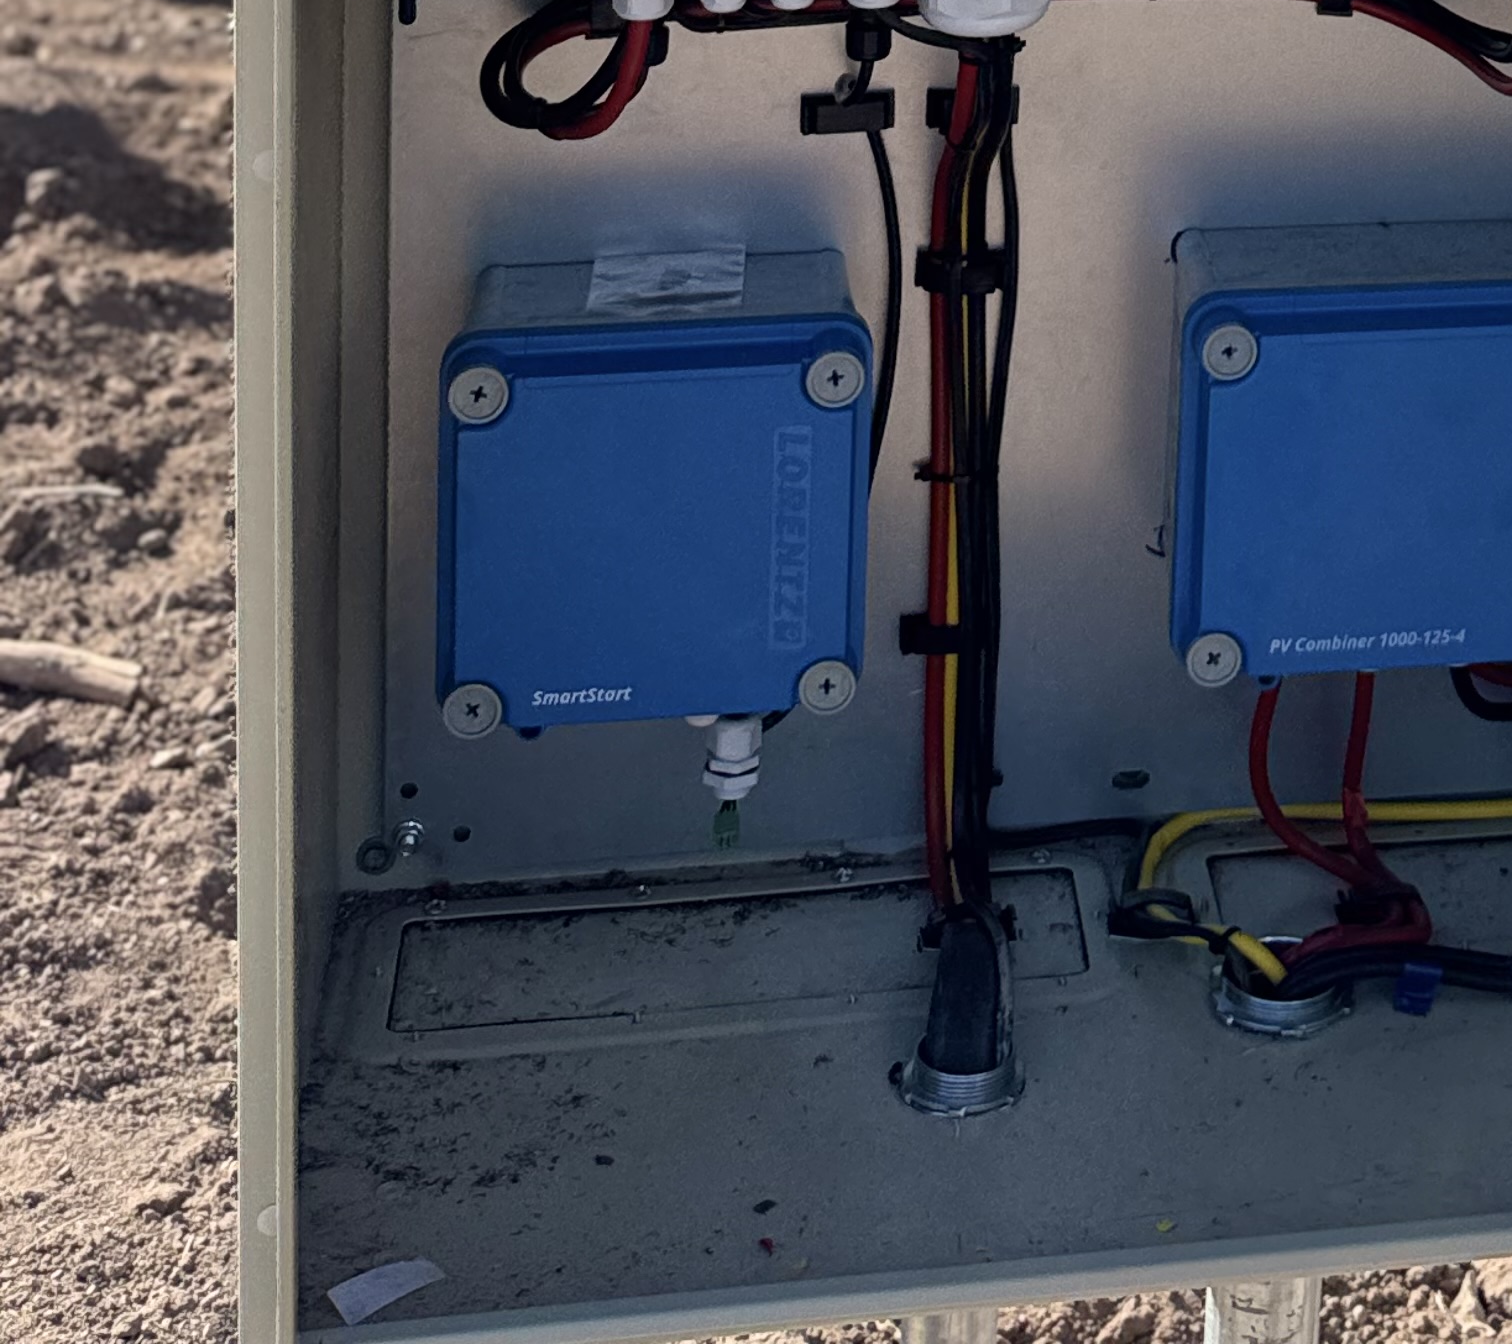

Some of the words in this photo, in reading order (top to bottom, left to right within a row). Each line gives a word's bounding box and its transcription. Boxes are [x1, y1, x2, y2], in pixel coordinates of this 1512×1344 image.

[1270, 638, 1292, 654] PV
[1295, 634, 1376, 653] Combiner
[1379, 628, 1466, 649] 1000-125-4
[531, 686, 633, 705] SmartStart
